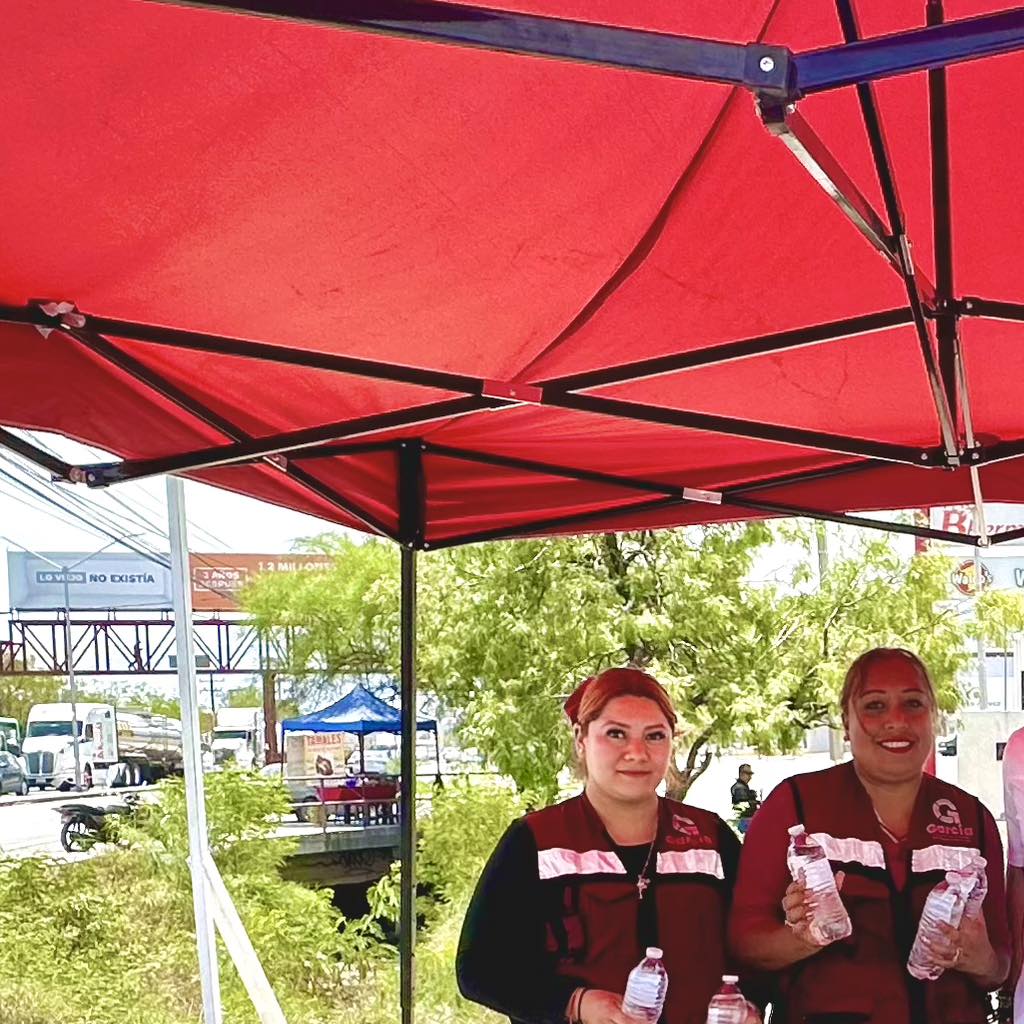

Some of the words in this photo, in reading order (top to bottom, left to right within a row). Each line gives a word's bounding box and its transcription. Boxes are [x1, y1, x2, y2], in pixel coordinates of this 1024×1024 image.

[39, 573, 53, 581] LO
[89, 573, 107, 583] NO
[110, 572, 155, 583] EXISTÍA
